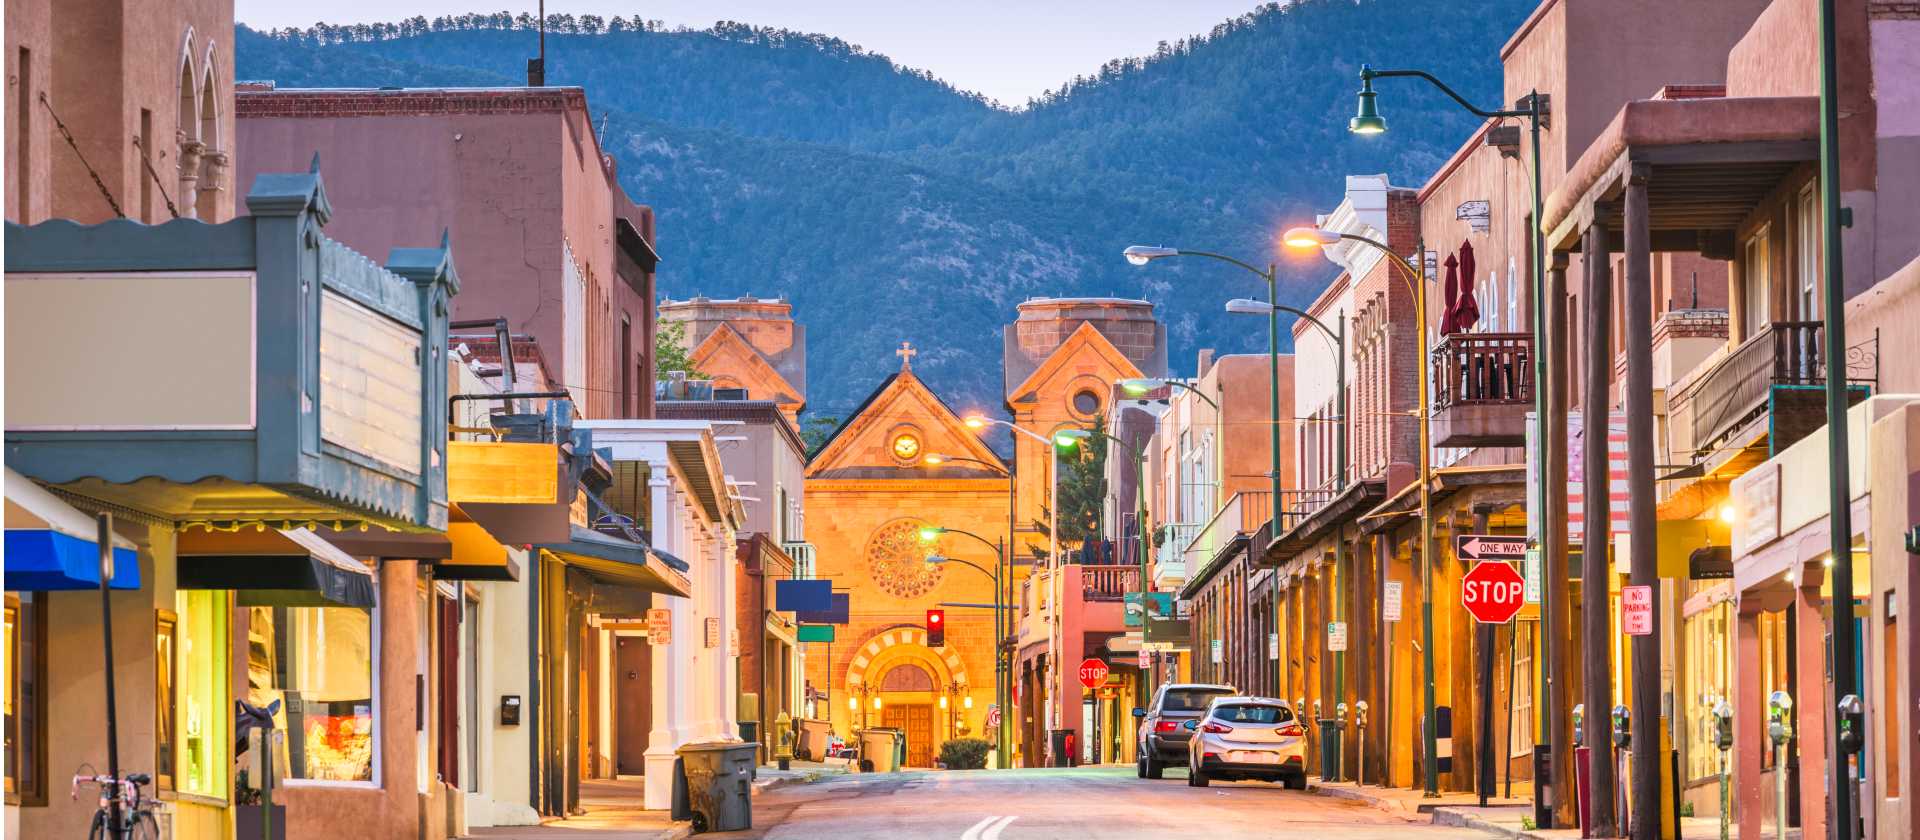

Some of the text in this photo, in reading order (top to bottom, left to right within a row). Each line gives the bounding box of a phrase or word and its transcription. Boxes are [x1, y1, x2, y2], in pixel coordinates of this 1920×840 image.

[1480, 544, 1523, 553] ONE WAY
[1465, 580, 1523, 604] STOP
[1632, 592, 1643, 600] NO
[1624, 603, 1650, 612] PARKING
[1081, 668, 1107, 679] STOP
